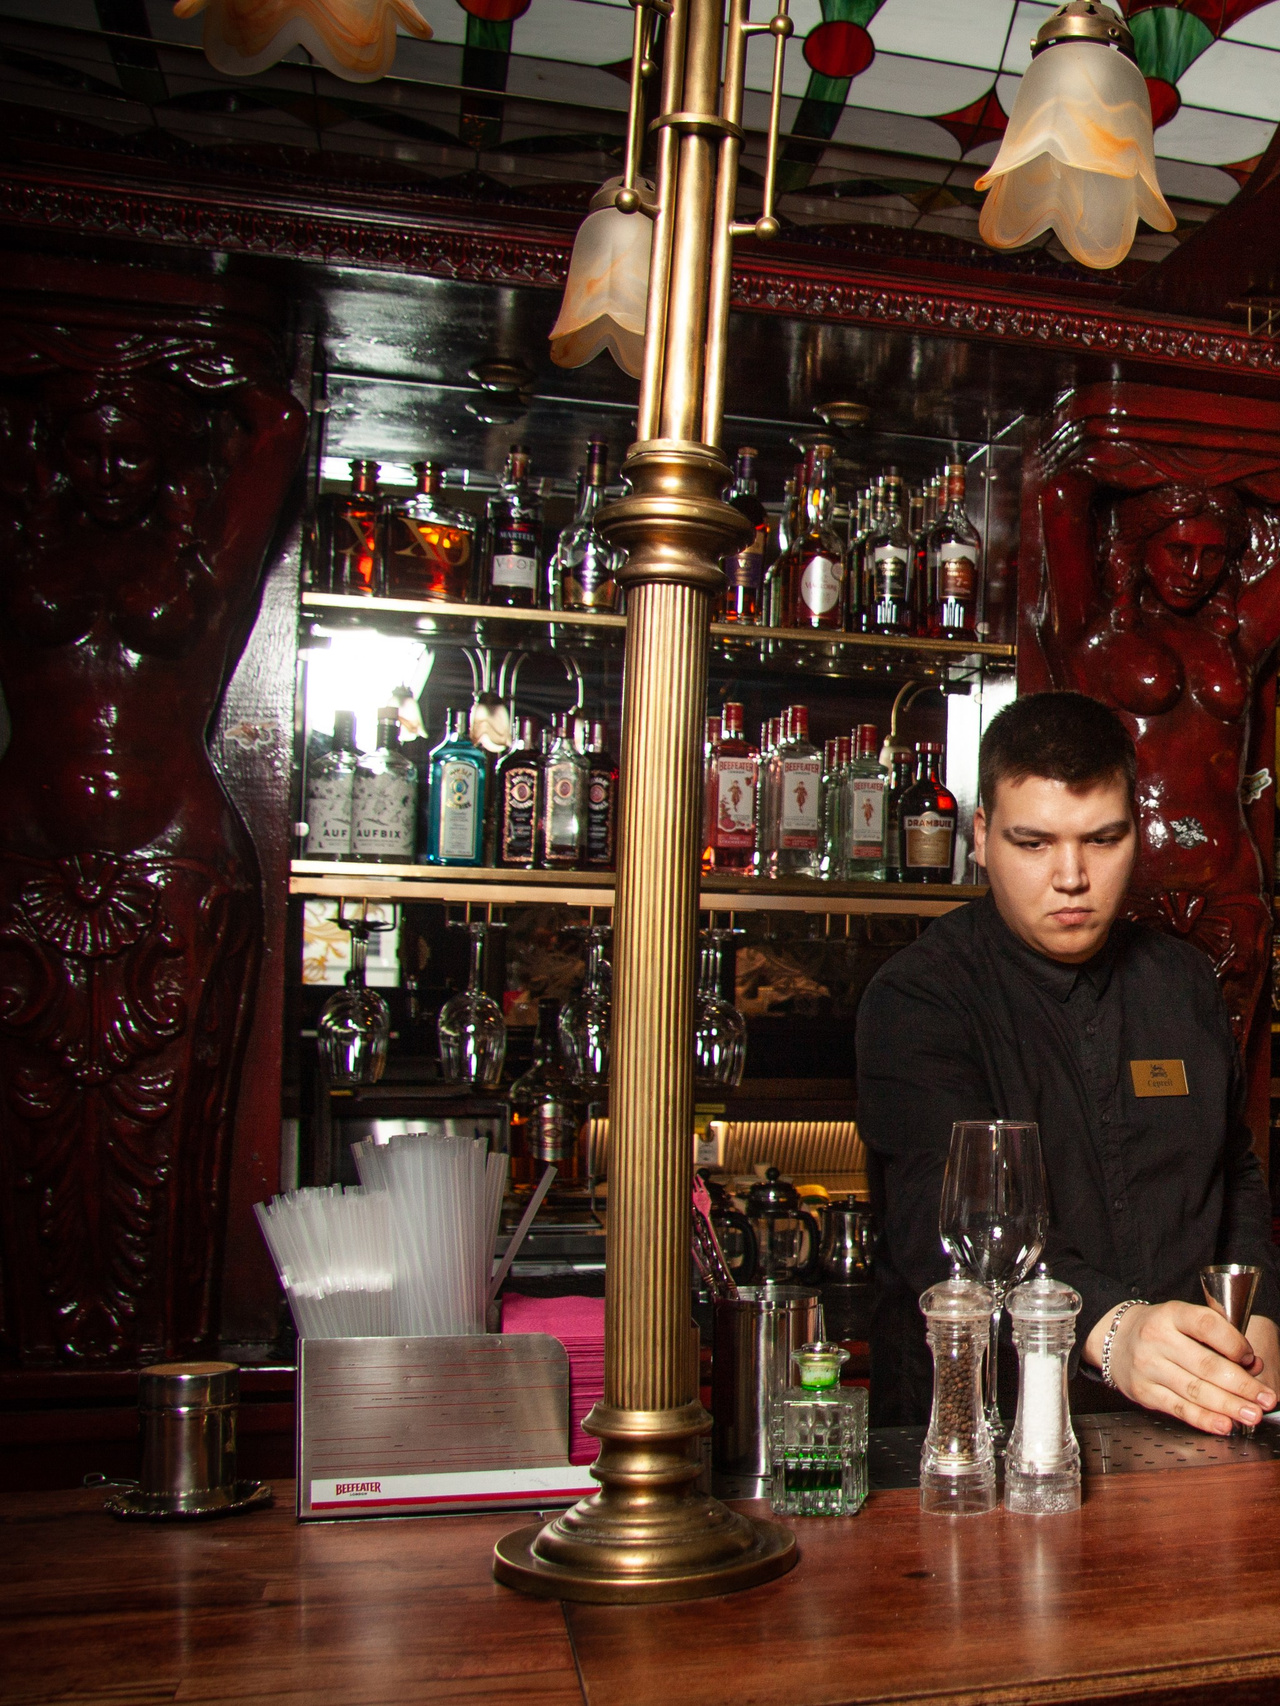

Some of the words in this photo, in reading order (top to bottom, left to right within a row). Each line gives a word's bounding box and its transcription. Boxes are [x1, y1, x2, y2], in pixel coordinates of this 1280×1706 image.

[395, 517, 470, 566] XO
[500, 532, 535, 541] MARTELL
[719, 761, 754, 771] BEEFEATER
[785, 762, 819, 774] BEEFEATER
[854, 781, 884, 792] BEEFEATER
[907, 819, 952, 828] DRAMBUIE
[335, 1482, 382, 1496] BEEFEATER
